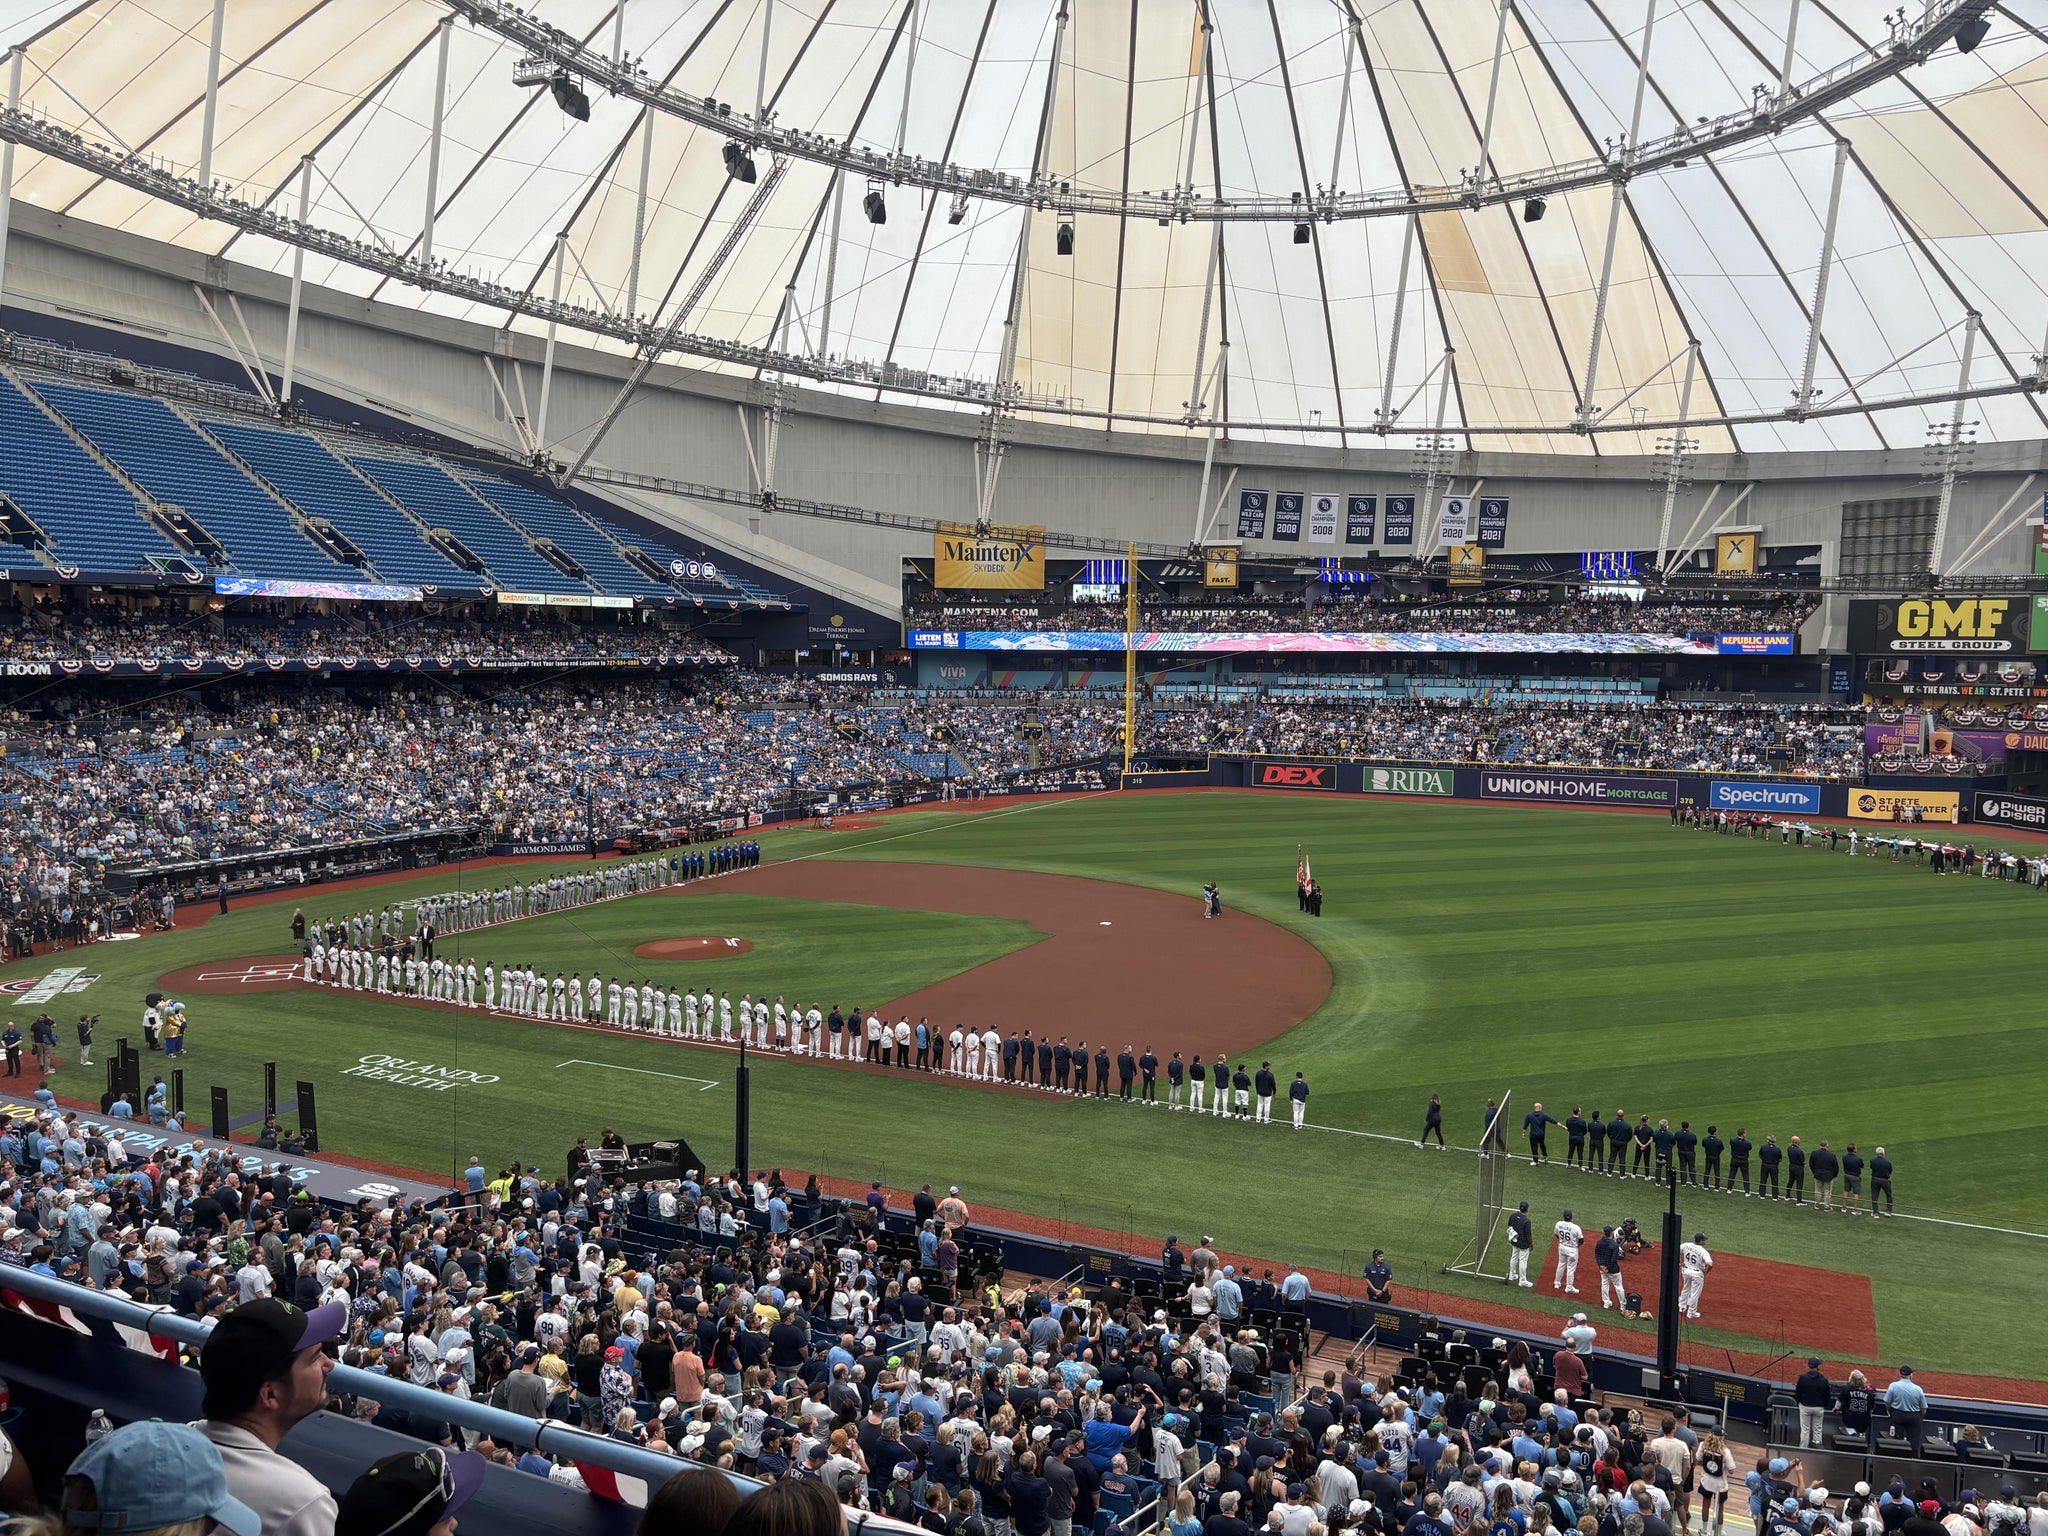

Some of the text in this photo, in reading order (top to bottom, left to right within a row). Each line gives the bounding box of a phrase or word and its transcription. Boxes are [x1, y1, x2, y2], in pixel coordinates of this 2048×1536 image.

[1276, 524, 1297, 534] 2008
[1312, 526, 1332, 535] 2008
[1350, 526, 1370, 536] 2010
[1388, 526, 1409, 536] 2020
[1442, 528, 1463, 538] 2020
[1482, 530, 1501, 540] 2021
[944, 542, 1034, 572] MaintenX
[673, 564, 682, 574] 42
[690, 564, 698, 574] 12
[704, 566, 714, 576] 66
[974, 564, 1006, 573] SKYDECK
[1897, 600, 2008, 638] GMF
[1722, 636, 1789, 644] REPUBLIC BANK
[1952, 642, 2003, 650] GROUP
[7, 664, 52, 676] ROOM
[940, 666, 966, 677] VIVA
[820, 674, 878, 682] SOMOS RAYS
[1903, 685, 1914, 694] WE
[1923, 686, 1938, 694] THE
[1939, 686, 1960, 695] RAYS.
[1962, 686, 1973, 695] WE
[1990, 688, 2003, 696] ST.
[2004, 688, 2024, 696] PETE
[1262, 766, 1326, 786] DEX
[1392, 770, 1445, 793] RIPA
[1607, 788, 1668, 800] MORTGAGE
[1719, 786, 1804, 804] Spectrum
[1879, 797, 1894, 805] ST.
[512, 844, 586, 854] RAYMOND JAMES
[358, 1054, 500, 1084] ORLANDO
[340, 1064, 458, 1091] HEALTH
[1559, 1230, 1570, 1242] 96
[1684, 1252, 1697, 1264] 46
[541, 1322, 554, 1335] 98
[1206, 1362, 1212, 1374] 3
[1850, 1399, 1868, 1412] 25
[1383, 1438, 1402, 1452] 44
[1452, 1504, 1470, 1523] 44
